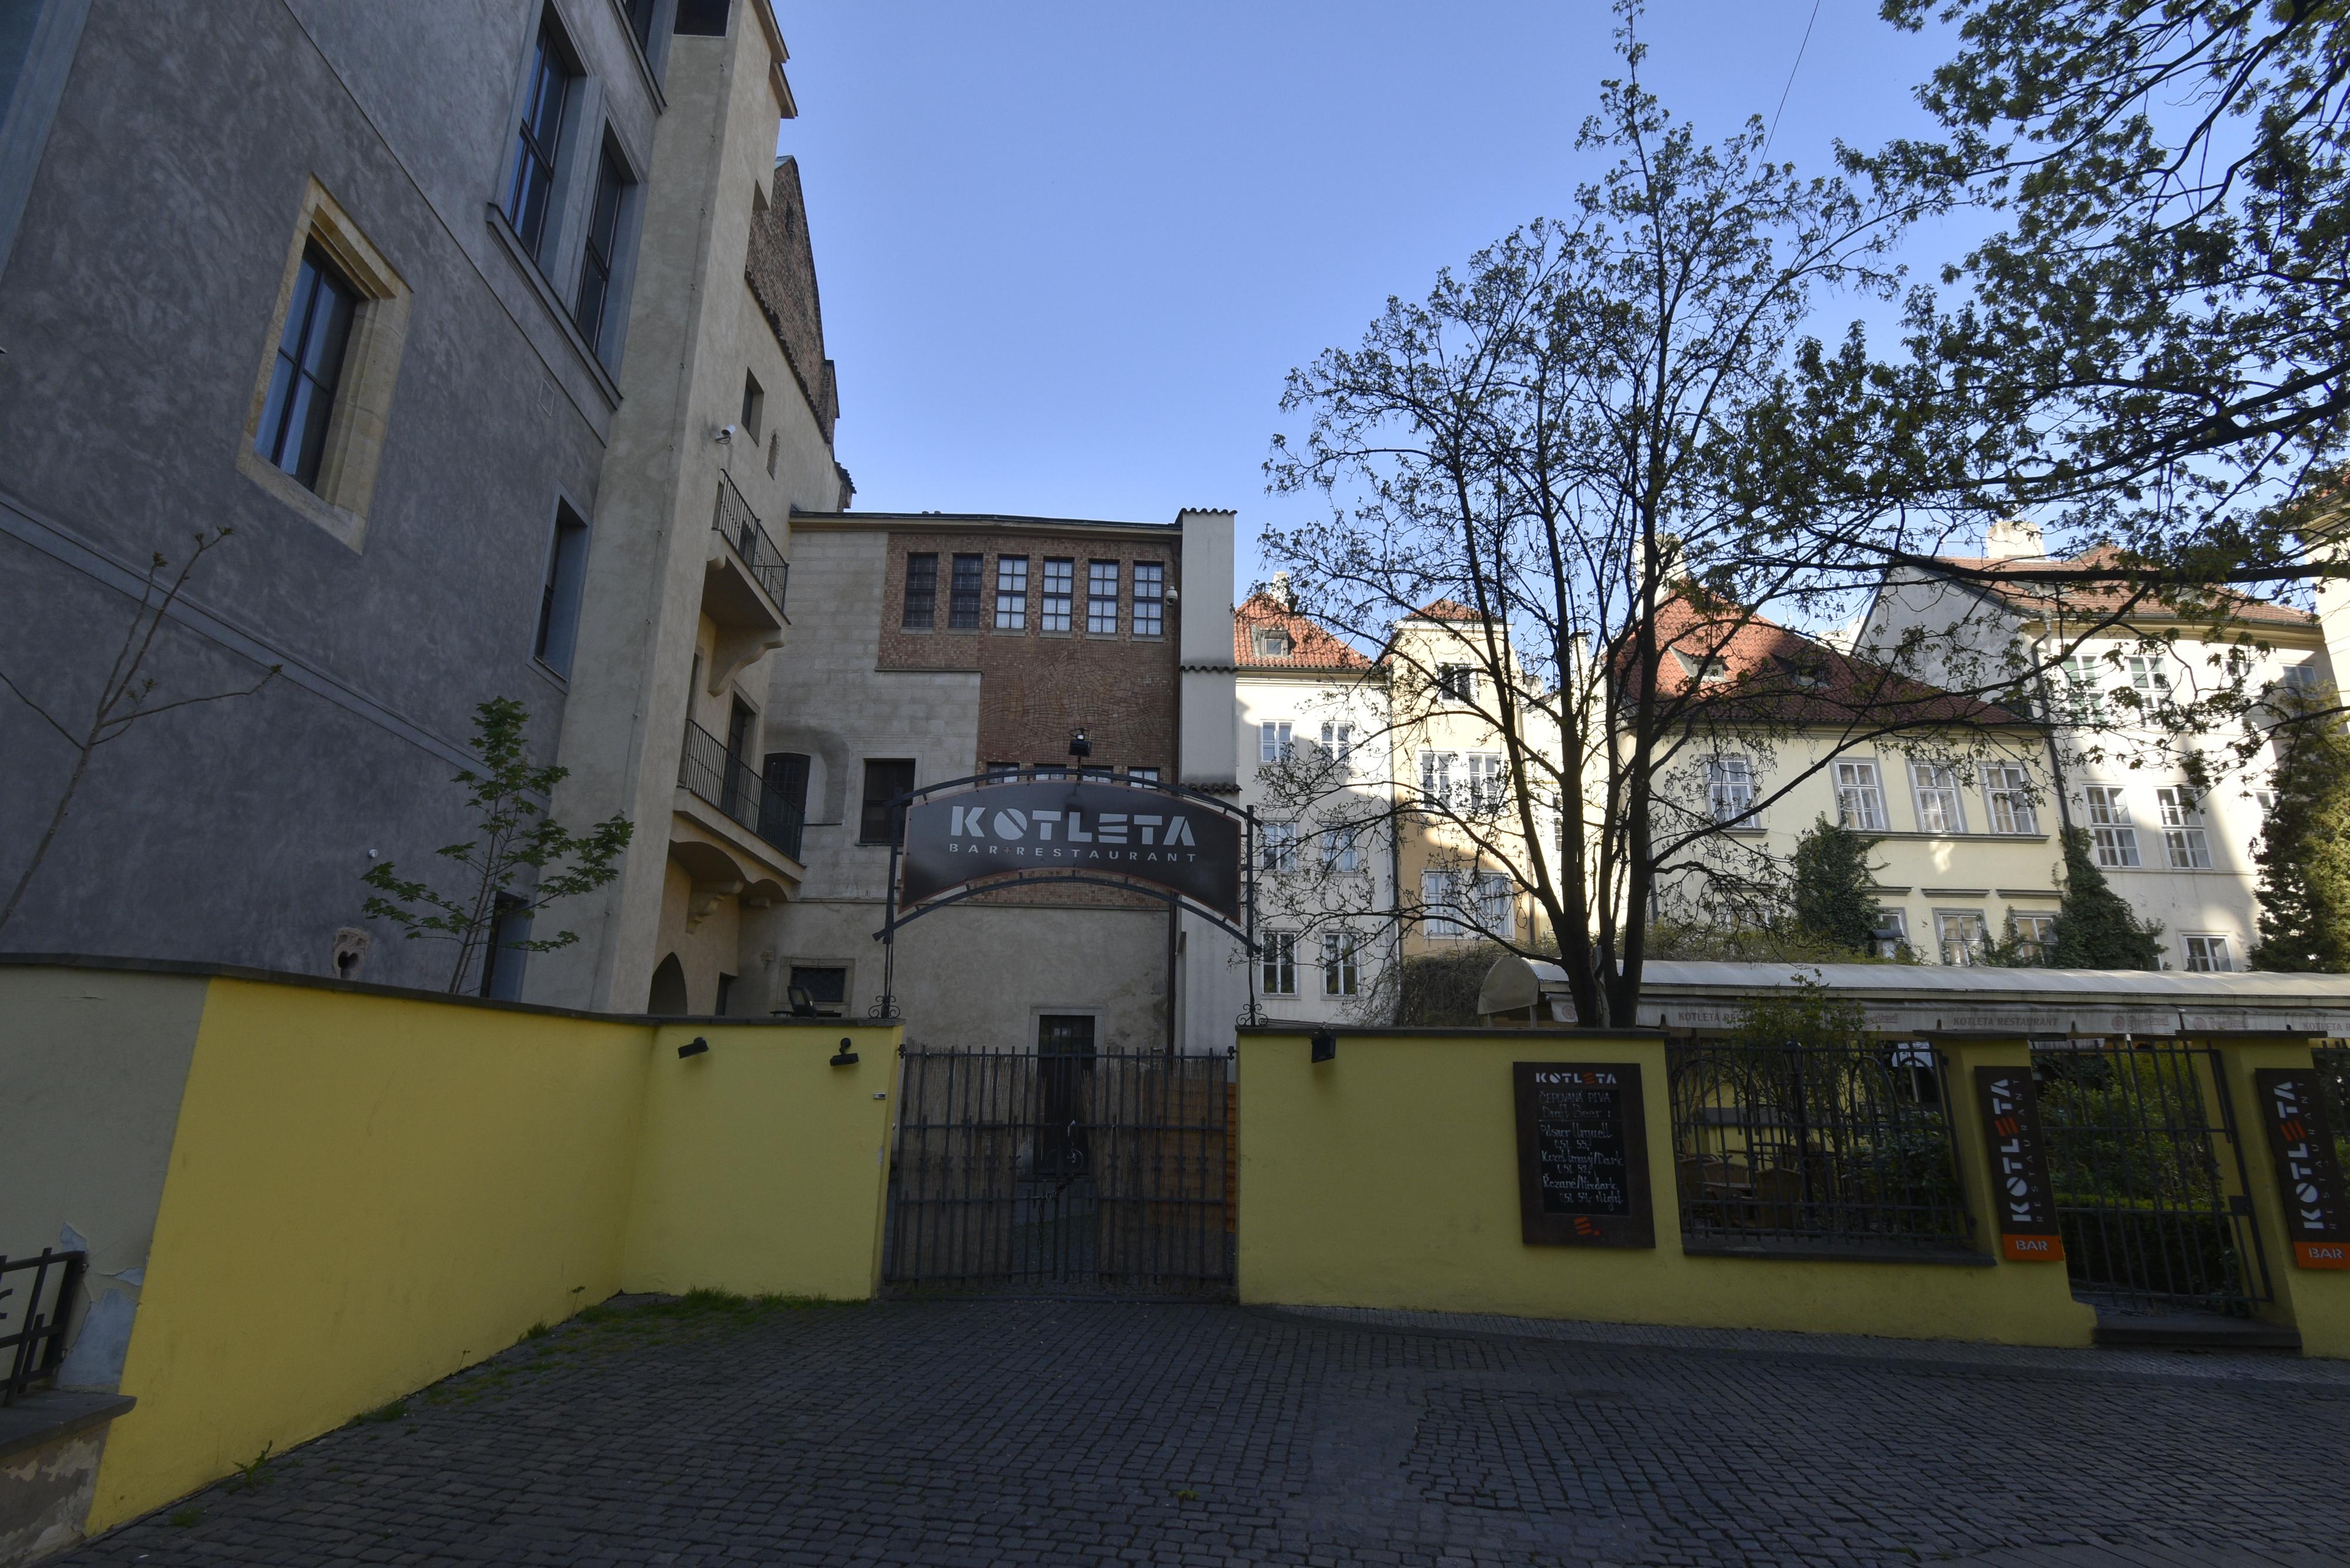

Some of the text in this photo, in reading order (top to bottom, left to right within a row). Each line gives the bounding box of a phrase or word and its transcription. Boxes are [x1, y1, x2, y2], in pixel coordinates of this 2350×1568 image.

[950, 805, 1196, 847] KOTLETA
[1678, 1012, 1720, 1022] KOTLETA
[1953, 1016, 2059, 1026] KOTLETA RESTAURANT
[2303, 1022, 2343, 1032] KOTLETA
[1535, 1072, 1617, 1084] KOTLETA
[1588, 1092, 1612, 1103] PIVA
[1542, 1103, 1570, 1122] Draft
[1990, 1079, 2032, 1222] KOTLETA
[2013, 1079, 2044, 1223] RESTAURANT
[2273, 1081, 2325, 1230] KOTLETA
[2297, 1083, 2337, 1230] RESTAURANT
[2015, 1240, 2049, 1251] BAR
[2308, 1247, 2344, 1259] BAR
